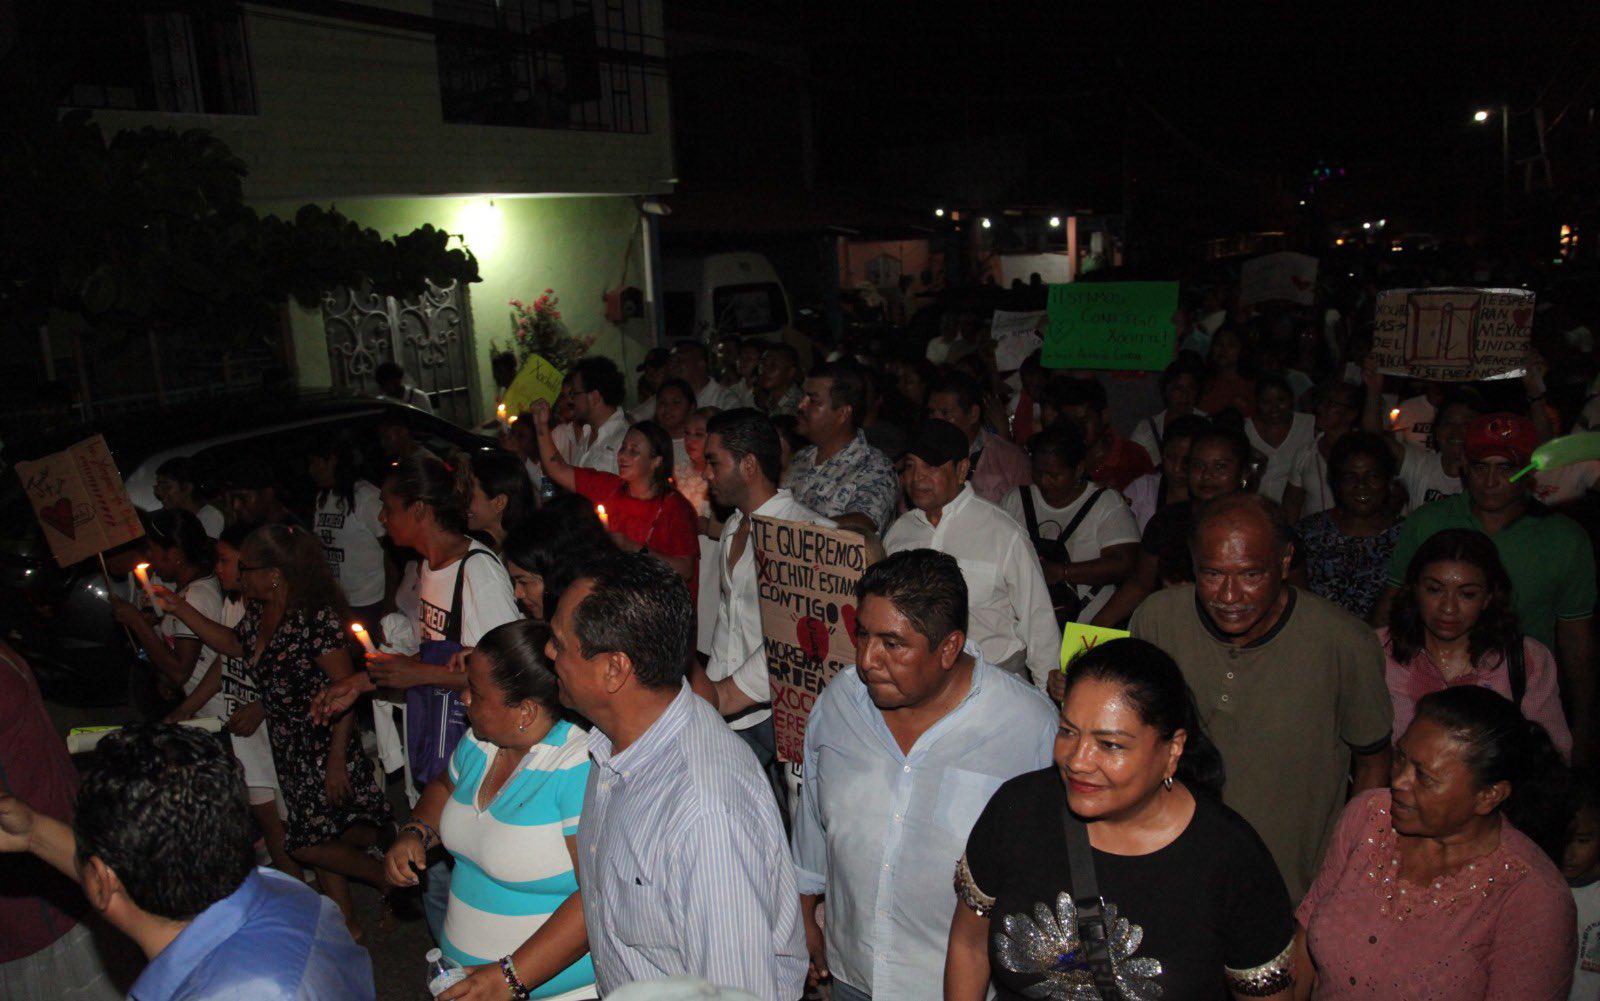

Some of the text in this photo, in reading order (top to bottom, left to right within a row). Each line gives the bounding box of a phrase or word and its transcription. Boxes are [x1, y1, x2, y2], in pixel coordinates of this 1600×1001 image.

[751, 518, 774, 552] TE
[760, 583, 839, 624] CONTIGO
[764, 636, 825, 675] MORENA
